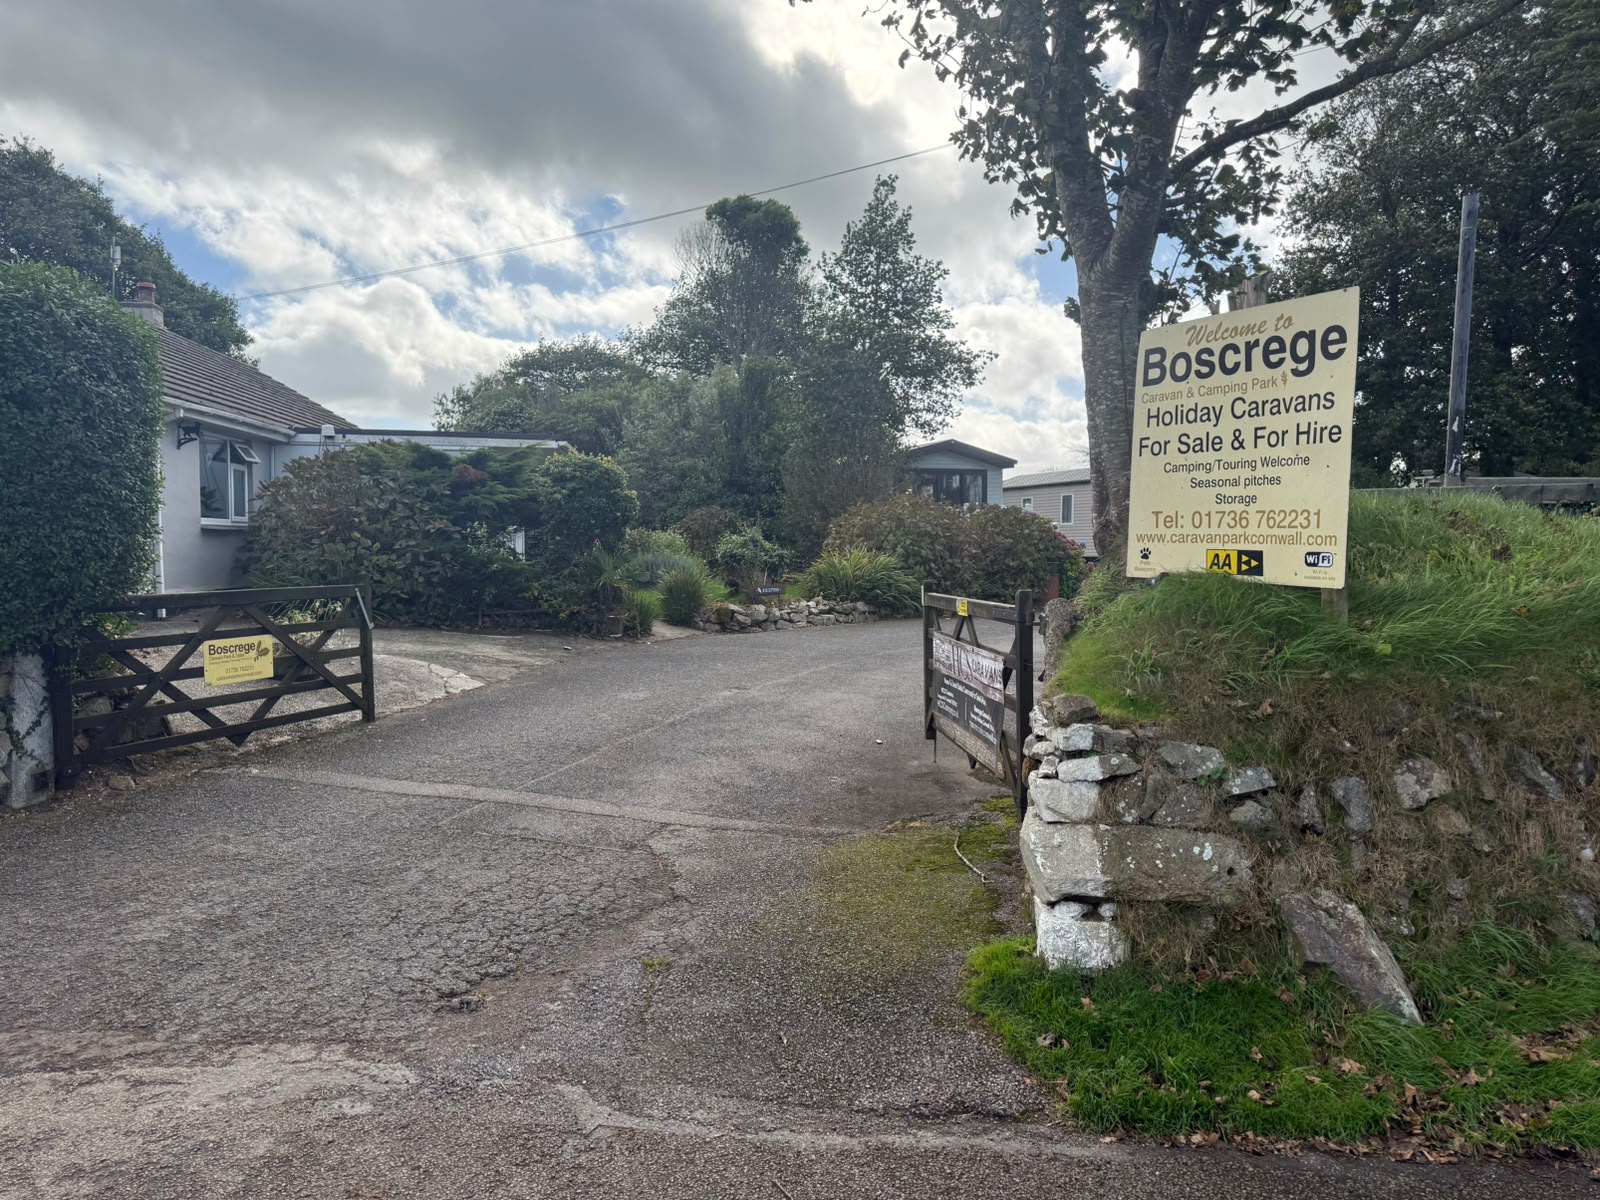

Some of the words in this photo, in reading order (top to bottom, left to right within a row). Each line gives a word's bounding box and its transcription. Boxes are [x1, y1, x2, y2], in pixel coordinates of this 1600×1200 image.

[1185, 319, 1268, 347] Welcome
[1273, 313, 1294, 330] to
[1142, 324, 1348, 388] Boscrege
[1141, 390, 1183, 404] Caravan
[1186, 387, 1195, 399] &
[1198, 380, 1248, 397] Camping
[1251, 376, 1278, 390] Park
[1146, 402, 1223, 428] Holiday
[1230, 390, 1336, 420] Caravans
[1138, 436, 1171, 457] For
[1177, 432, 1223, 455] Sale
[1230, 428, 1245, 450] &
[1253, 425, 1289, 449] For
[1295, 421, 1342, 446] Hire
[1163, 456, 1257, 475] Camping/Touring
[1260, 454, 1310, 468] Welcome
[1189, 476, 1241, 489] Seasonal
[1243, 474, 1282, 490] pitches
[1215, 493, 1257, 506] Storage
[1151, 510, 1184, 529] Tel:
[1191, 510, 1250, 529] 01736
[1255, 509, 1322, 530] 762231
[1136, 530, 1338, 547] www.caravanparkcornwall.com
[1208, 552, 1232, 571] AA
[208, 642, 256, 656] Boscrege
